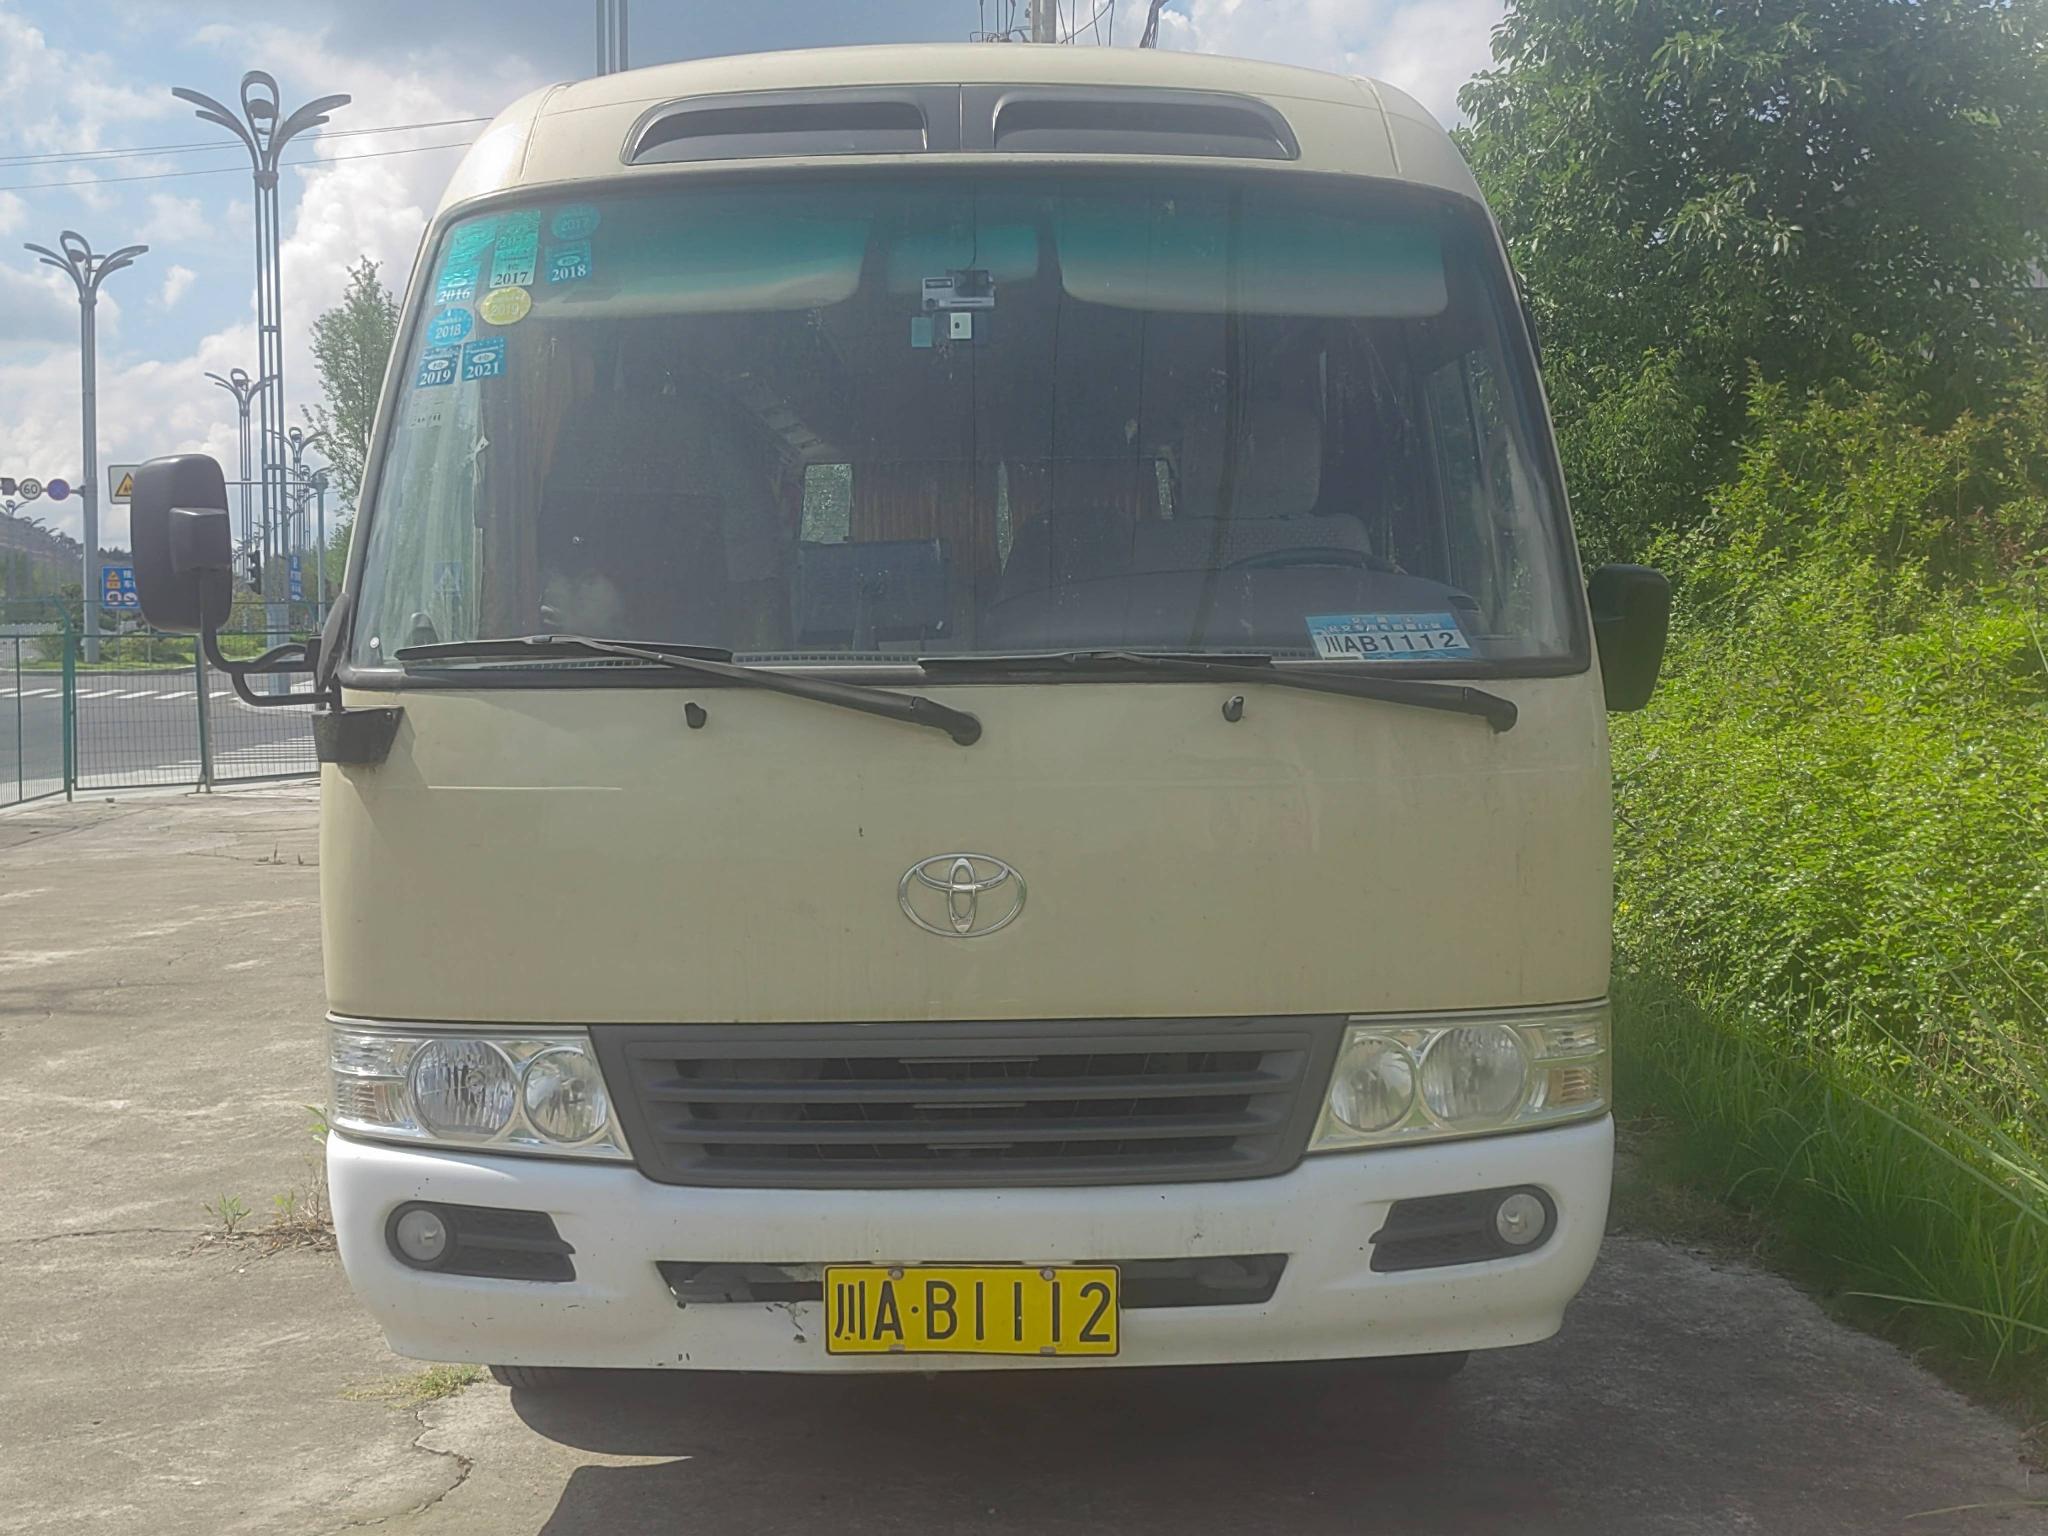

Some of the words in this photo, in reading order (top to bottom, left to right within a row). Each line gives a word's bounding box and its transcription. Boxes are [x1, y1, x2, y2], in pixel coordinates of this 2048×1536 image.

[494, 271, 529, 286] 2017
[551, 264, 587, 282] 2018
[418, 369, 452, 386] 2019
[466, 361, 499, 379] 2021
[23, 483, 38, 495] 60
[1324, 631, 1459, 654] 川AB1112
